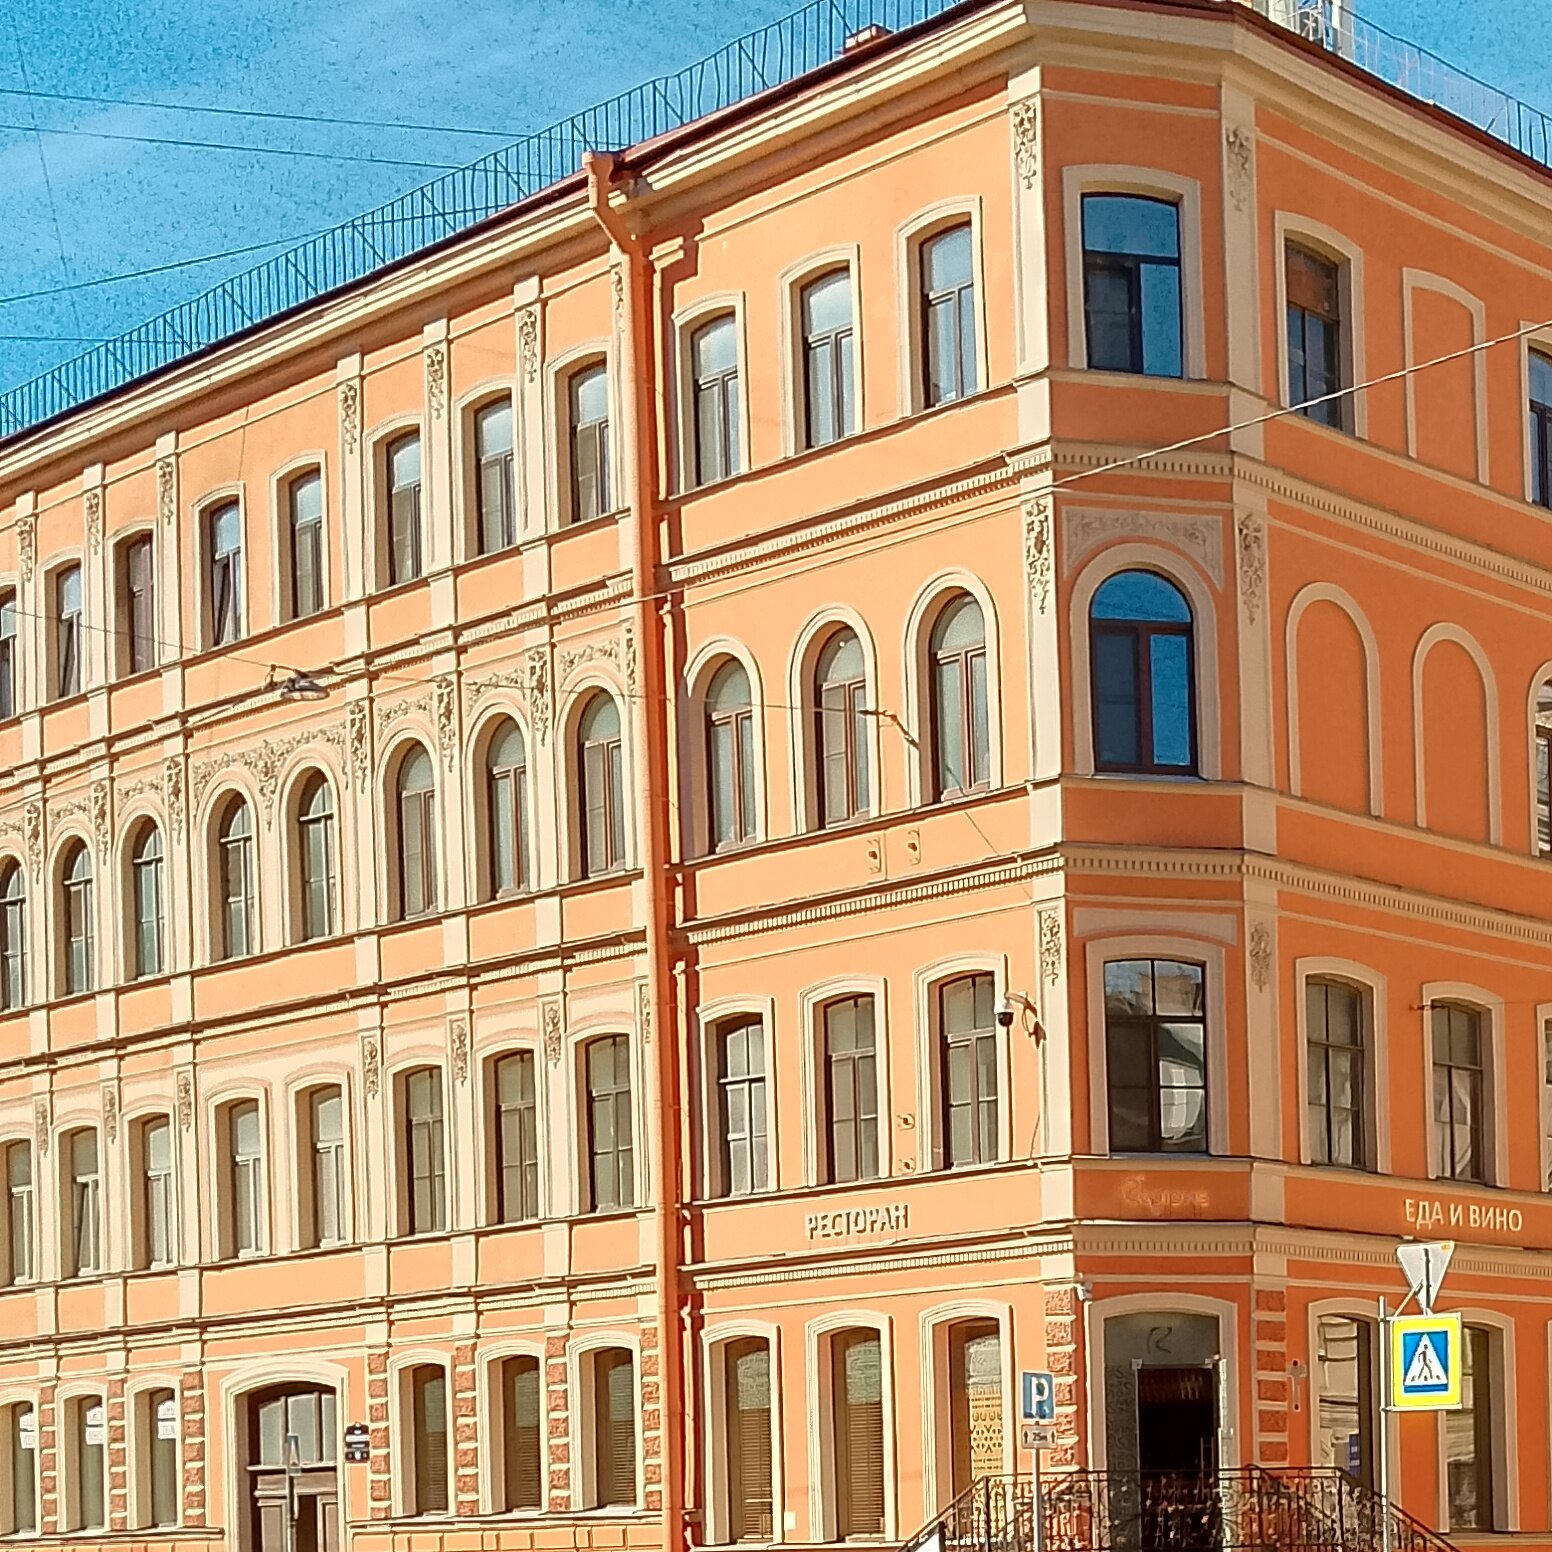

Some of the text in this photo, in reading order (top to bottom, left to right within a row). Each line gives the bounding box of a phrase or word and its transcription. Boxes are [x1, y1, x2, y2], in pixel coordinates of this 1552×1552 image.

[806, 1203, 909, 1240] РЕСТОРАН
[1404, 1198, 1523, 1232] ЕДА И ВИНО
